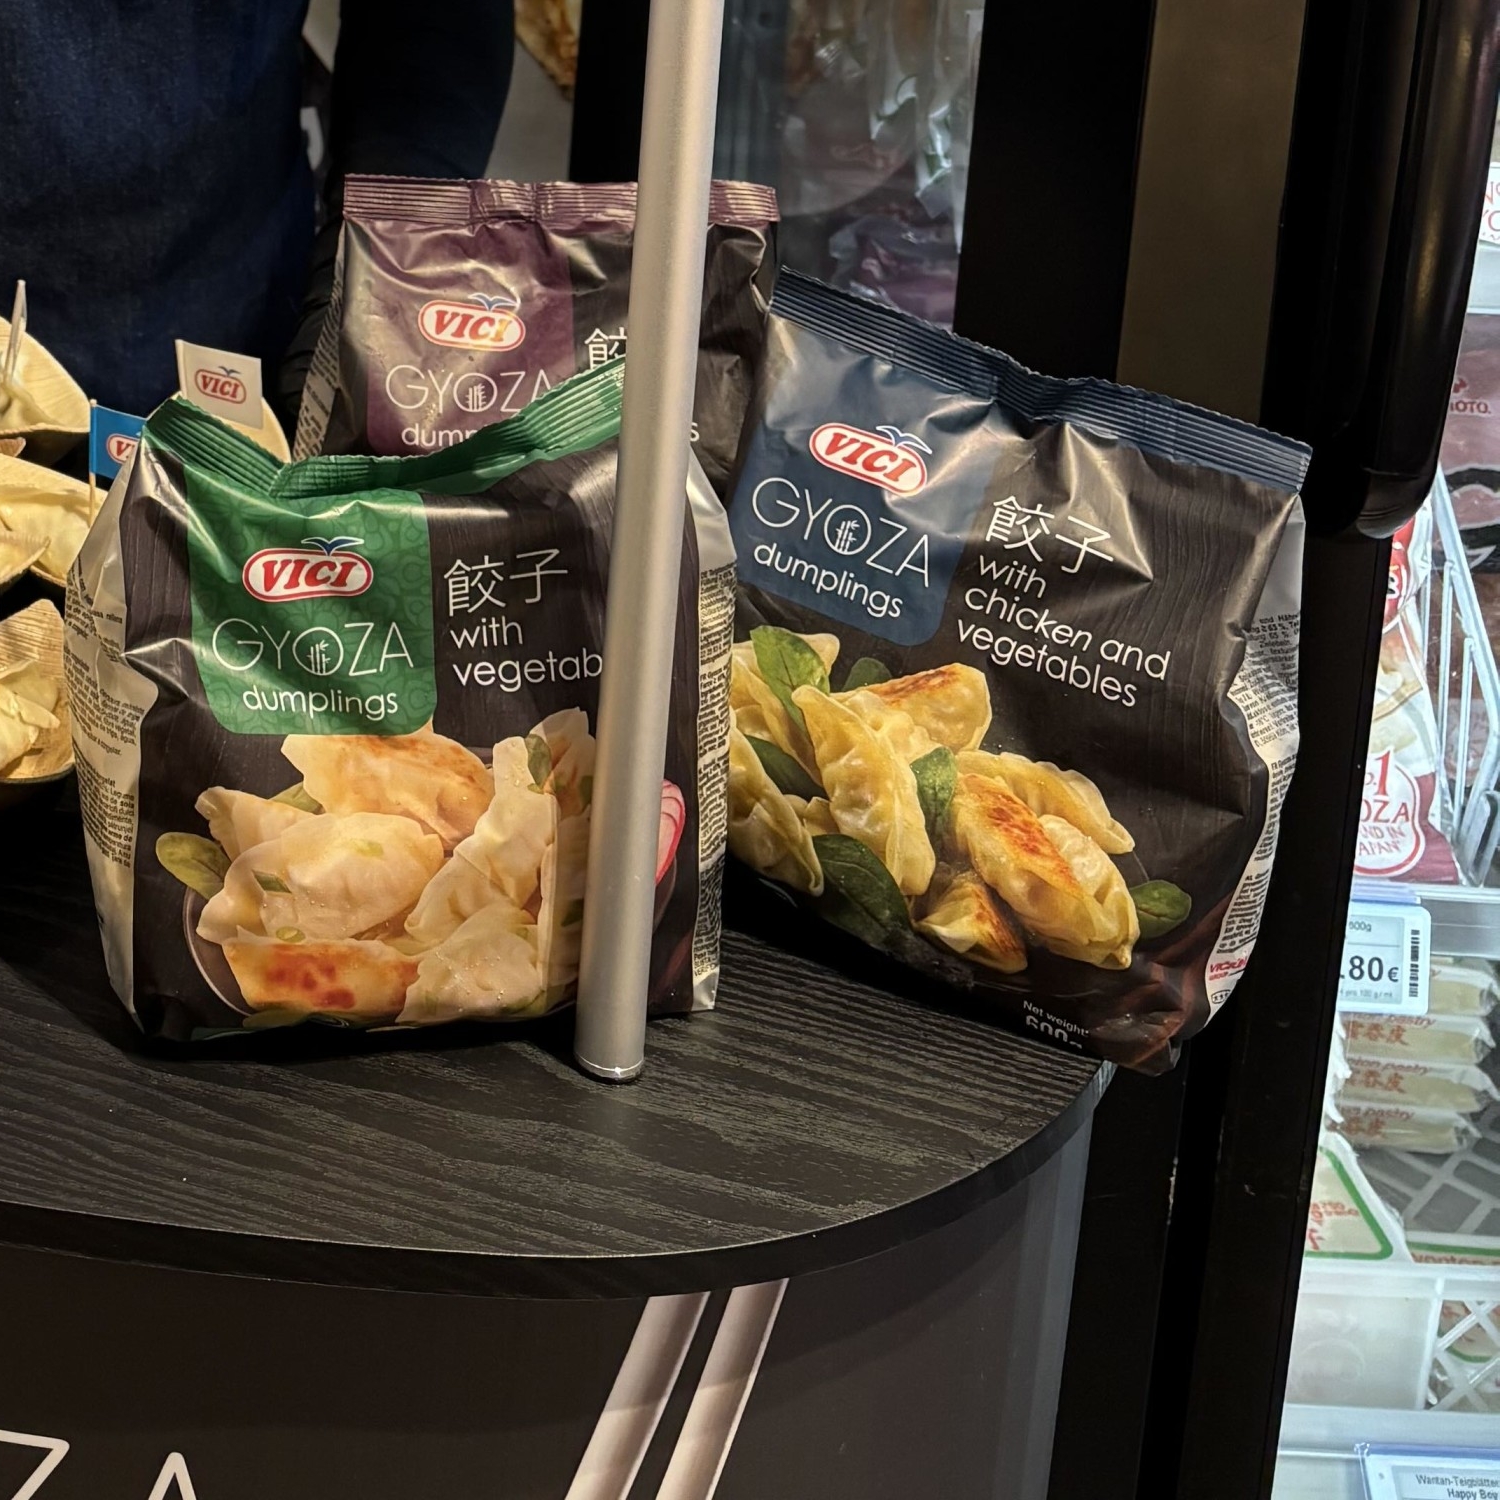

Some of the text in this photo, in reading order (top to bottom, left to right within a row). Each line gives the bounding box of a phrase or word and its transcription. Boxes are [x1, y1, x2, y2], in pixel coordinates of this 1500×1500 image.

[434, 311, 512, 343] VICI
[200, 374, 242, 401] VICI
[825, 432, 917, 482] VICI
[752, 477, 929, 588] GYOZA
[985, 495, 1114, 574] 餃子
[262, 559, 355, 592] VICI
[443, 548, 569, 617] 餃子
[754, 543, 903, 618] dumplings
[979, 554, 1047, 599] with
[211, 617, 415, 677] GYOZA
[449, 617, 524, 651] with
[965, 587, 1171, 681] chicken and
[452, 648, 603, 693] vegetab
[957, 618, 1138, 708] vegetables
[242, 685, 399, 721] dumplings
[1358, 840, 1402, 856] APAN
